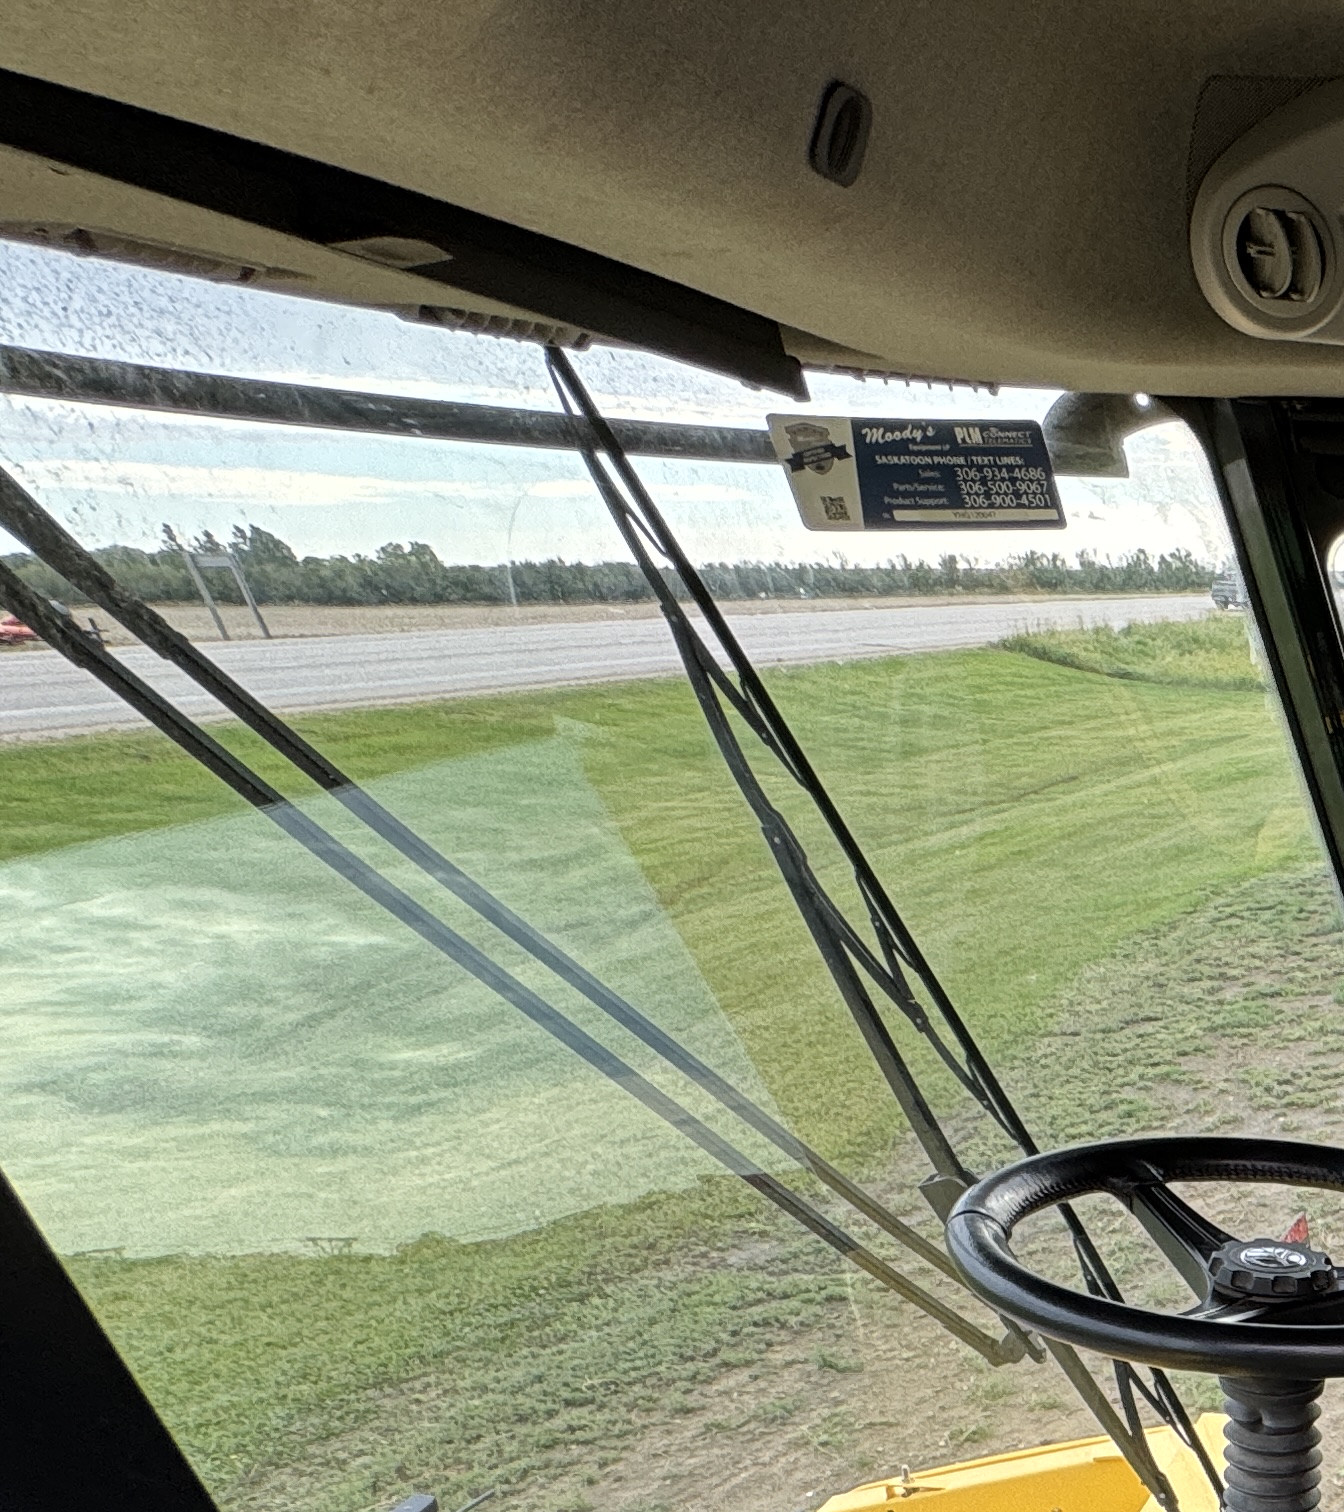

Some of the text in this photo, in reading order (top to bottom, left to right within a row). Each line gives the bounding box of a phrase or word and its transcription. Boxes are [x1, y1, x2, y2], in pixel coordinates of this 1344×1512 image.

[861, 421, 936, 444] Moody's
[954, 426, 983, 444] PLM
[983, 429, 1032, 438] CONNECT
[875, 455, 933, 465] SASKATOON
[933, 456, 965, 465] PHONE
[972, 456, 993, 465] TEXT
[954, 467, 1046, 480] 306-934-4686
[959, 480, 1048, 494] 306-500-9067
[963, 494, 1051, 508] 306-900-4501
